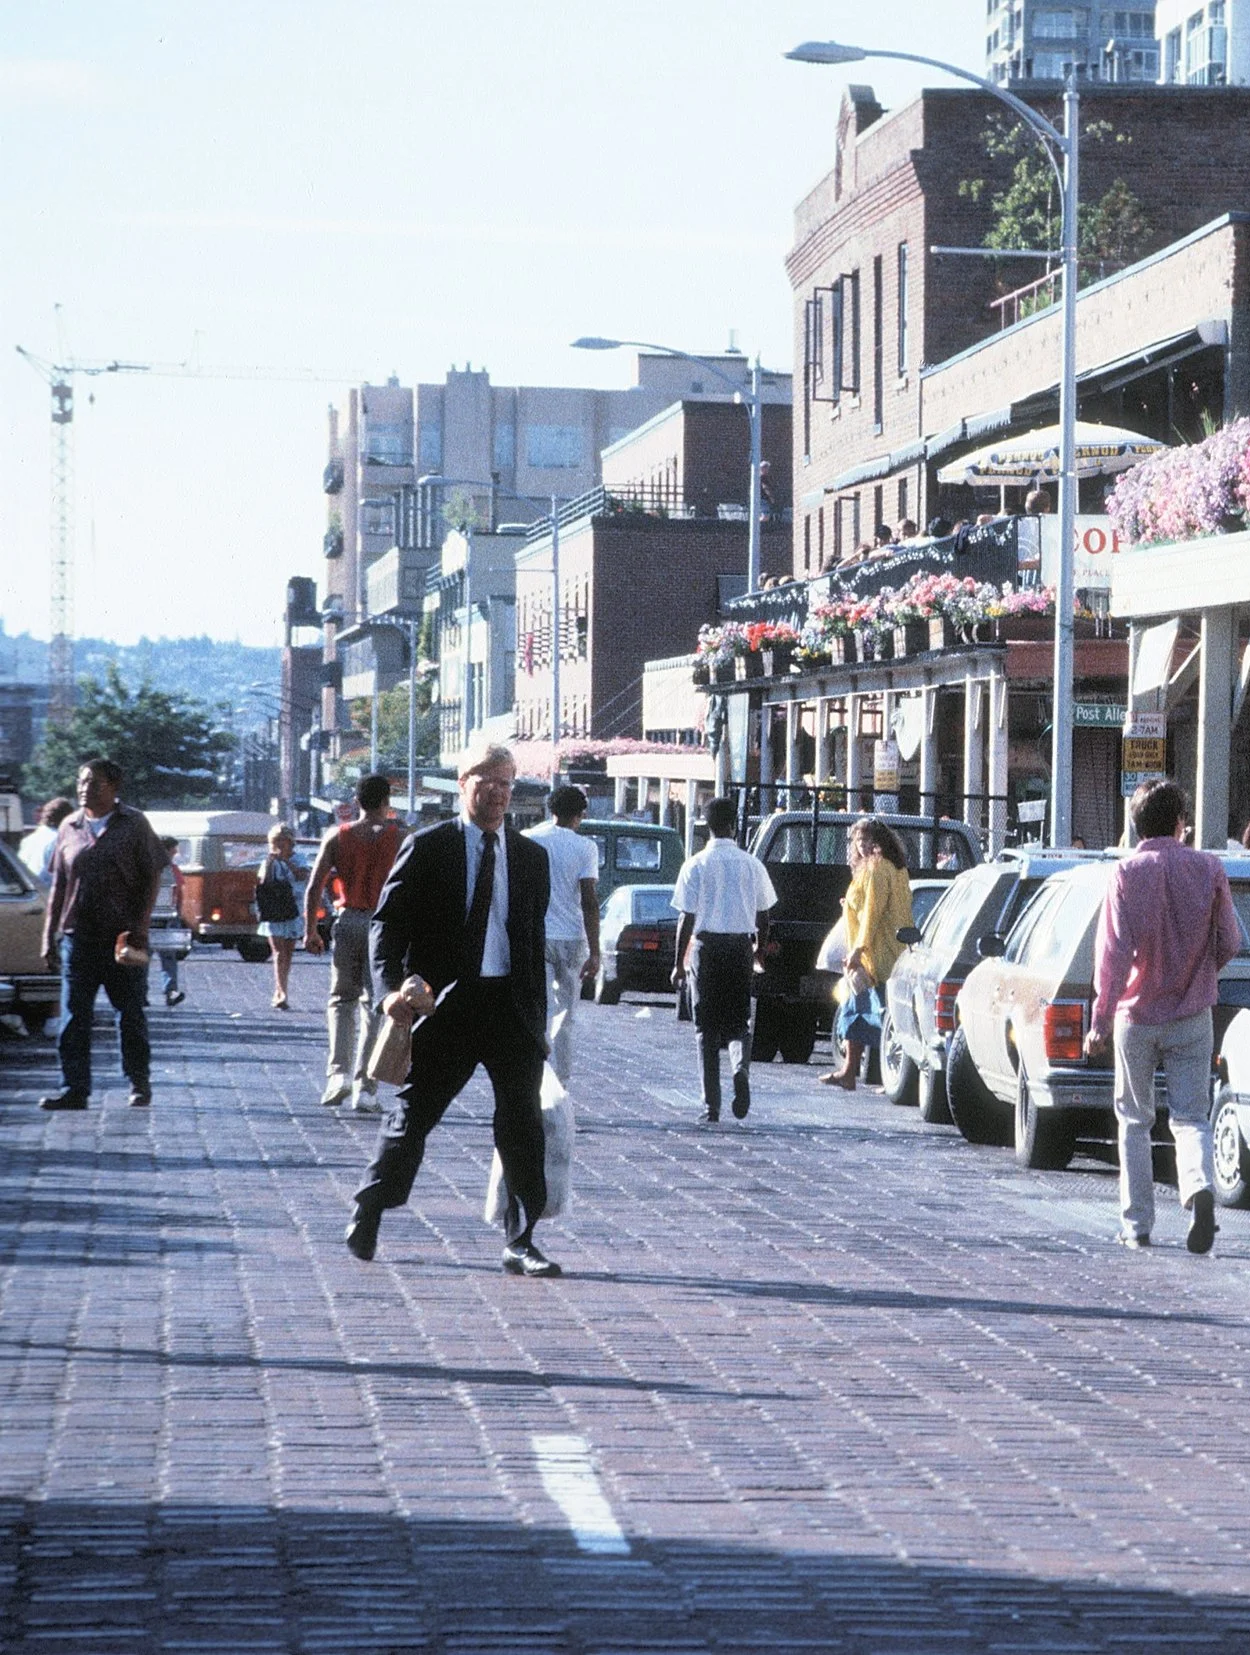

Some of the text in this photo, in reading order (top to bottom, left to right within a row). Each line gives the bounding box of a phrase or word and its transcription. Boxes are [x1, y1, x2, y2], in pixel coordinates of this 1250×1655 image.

[1076, 706, 1100, 720] Post
[1105, 707, 1127, 721] Alle
[1130, 740, 1159, 750] TRUCK
